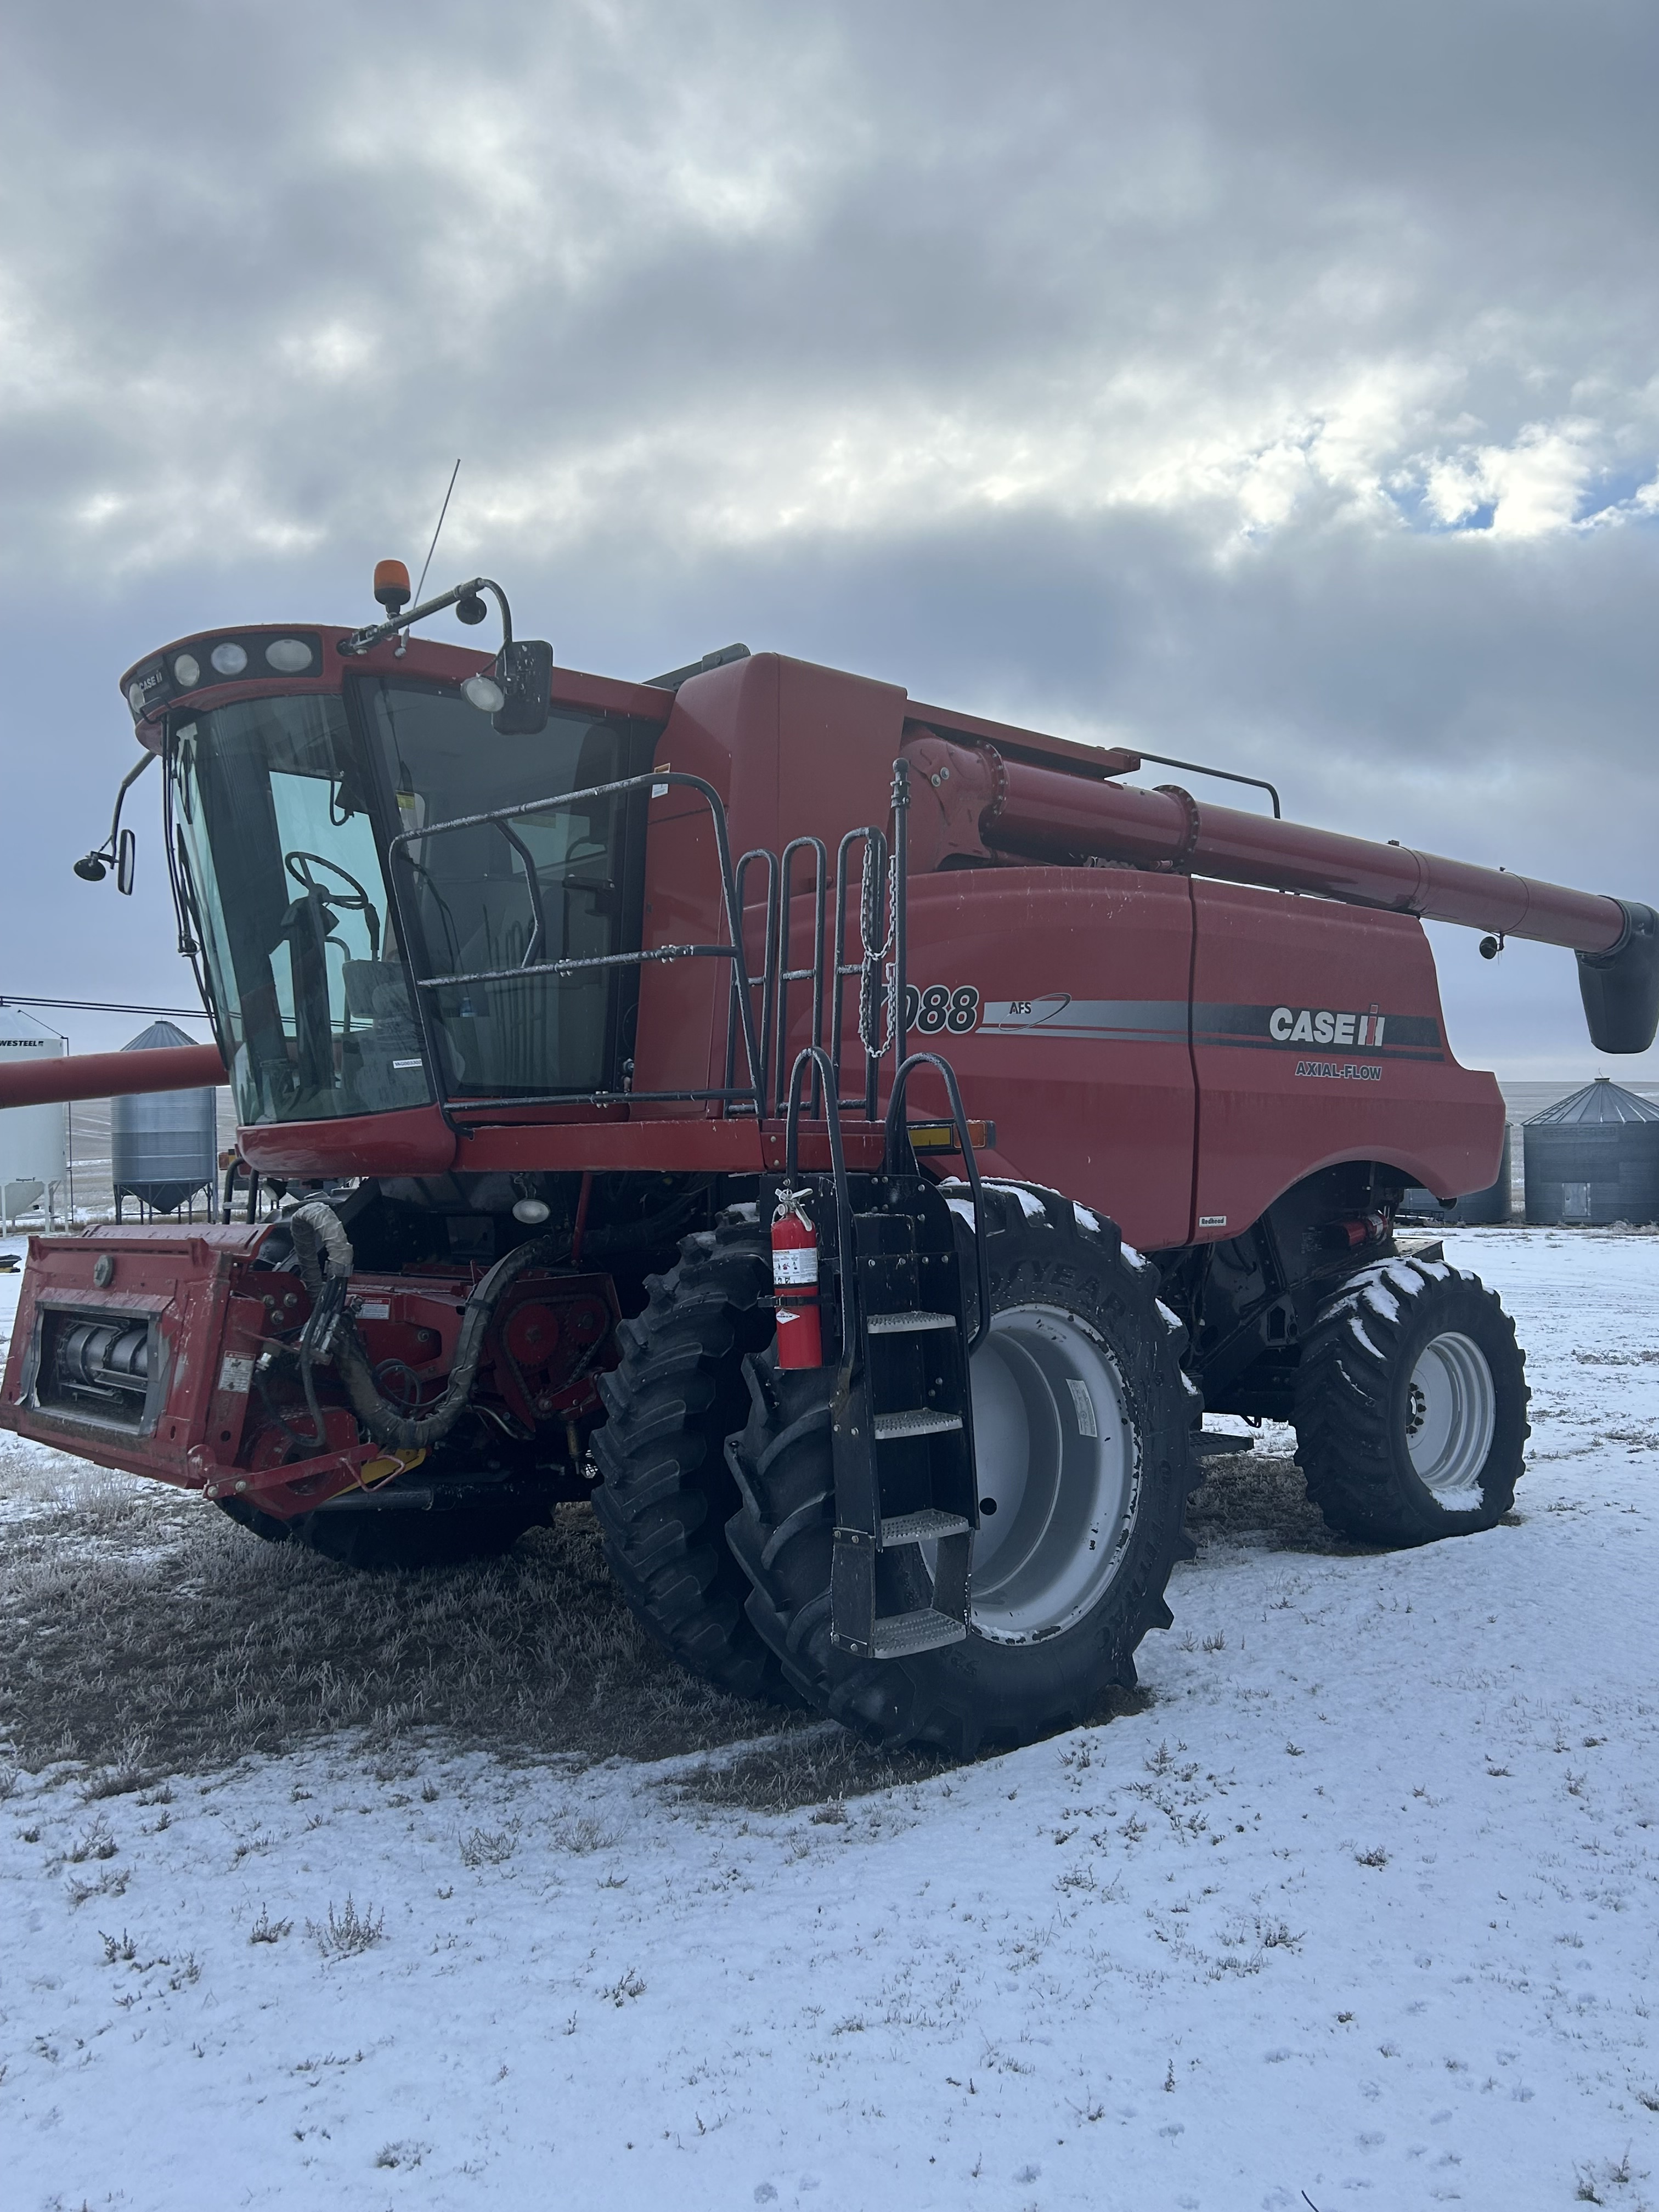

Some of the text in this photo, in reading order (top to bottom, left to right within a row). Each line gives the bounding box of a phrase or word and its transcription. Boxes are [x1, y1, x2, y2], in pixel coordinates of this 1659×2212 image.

[139, 676, 156, 692] CASE
[1009, 1001, 1031, 1015] AFS
[1269, 1007, 1356, 1044] CASE
[1295, 1061, 1382, 1081] AXIAL-FLOW
